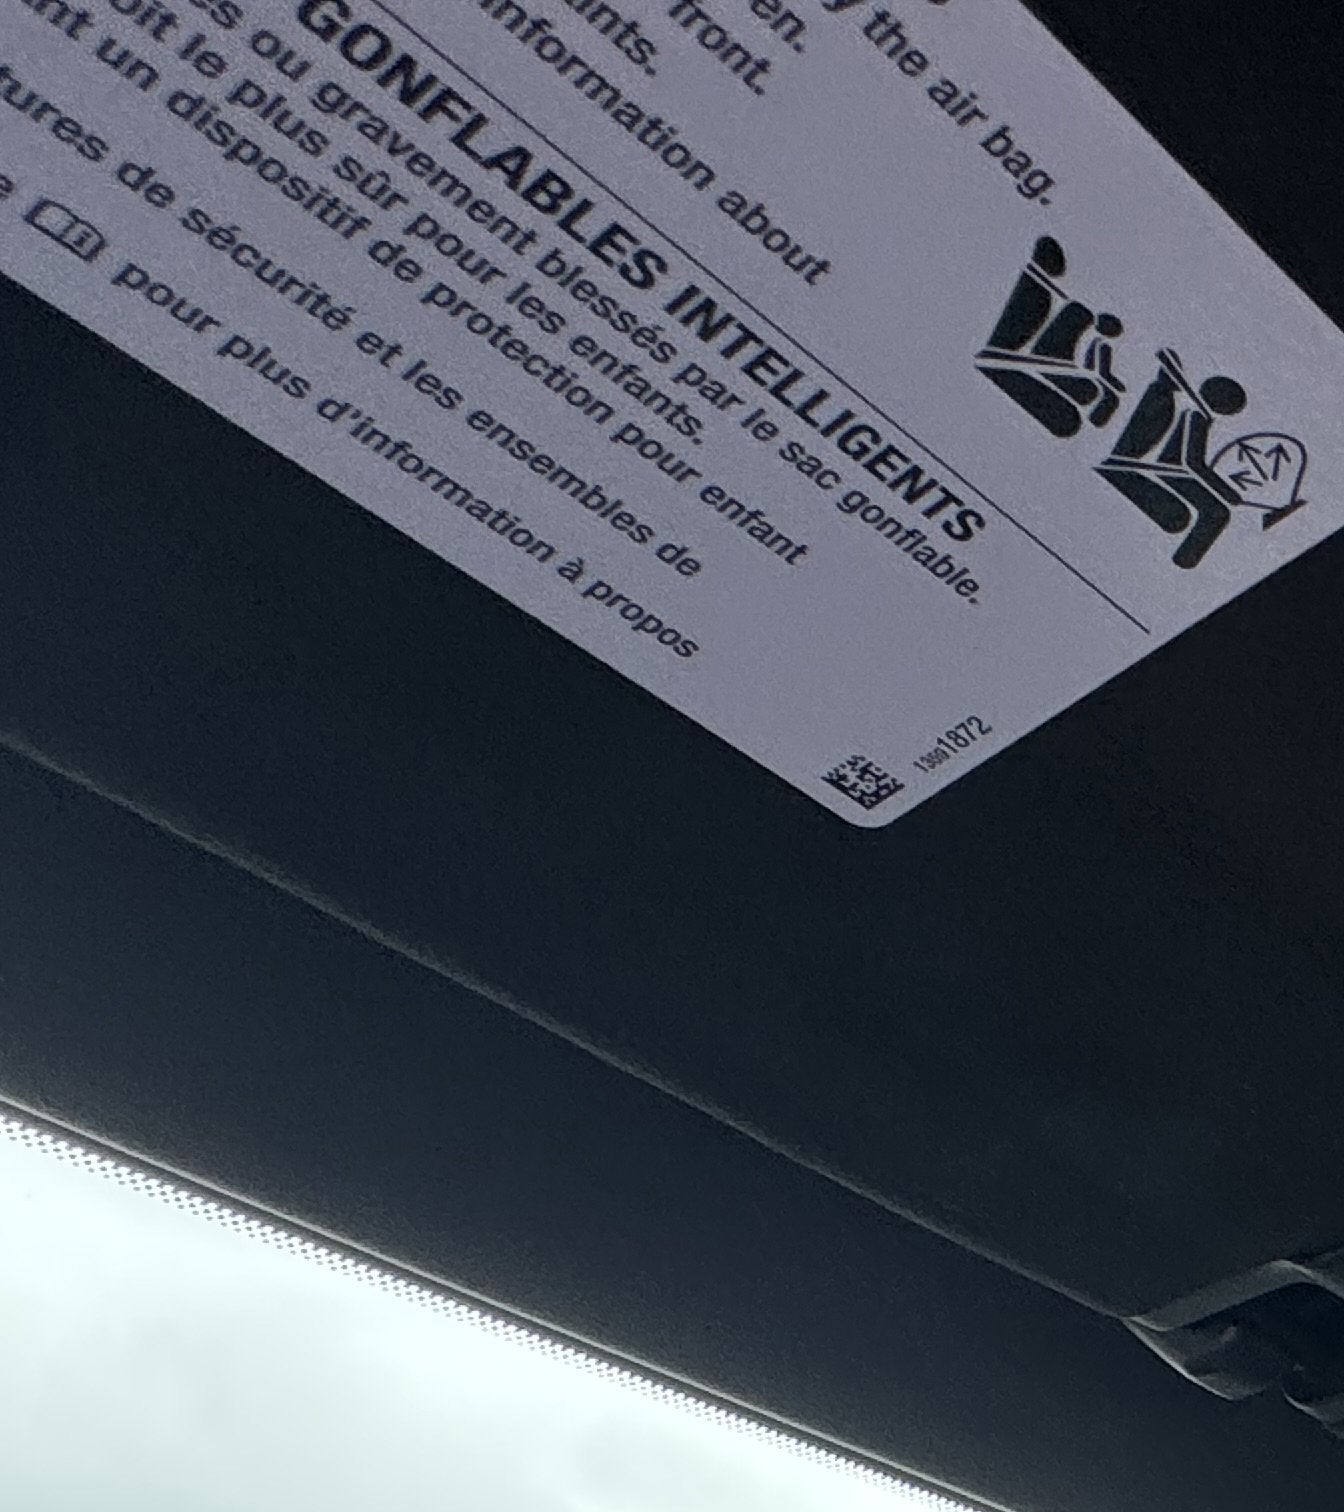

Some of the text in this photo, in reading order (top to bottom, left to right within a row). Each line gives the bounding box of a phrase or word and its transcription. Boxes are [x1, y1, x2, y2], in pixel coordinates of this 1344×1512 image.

[178, 33, 229, 79] le
[226, 78, 329, 157] plus
[333, 156, 409, 210] sûr
[403, 212, 507, 284] pour
[506, 282, 566, 334] les
[569, 334, 703, 446] enfants.
[477, 0, 831, 286] nformation about
[563, 0, 657, 77] nts.
[863, 10, 1055, 205] the air bag.
[22, 0, 808, 566] nt un dispositif de protection pour enfant
[111, 263, 222, 333] pour
[216, 334, 312, 399] plus
[316, 399, 557, 563] d'information
[557, 557, 585, 583] à
[582, 580, 700, 658] propos
[117, 162, 175, 208] de
[180, 208, 356, 331] sécurité
[356, 331, 403, 368] et
[401, 359, 465, 410] les
[466, 409, 655, 544] ensembles
[656, 542, 702, 577] de
[250, 29, 311, 82] ou
[310, 80, 539, 255] gravement
[535, 247, 678, 364] blessés
[672, 361, 745, 412] par
[740, 407, 779, 442] le
[779, 441, 842, 492] sac
[836, 489, 980, 604] gonflable.
[296, 0, 986, 542] GONFLABLES INTELLIGENTS
